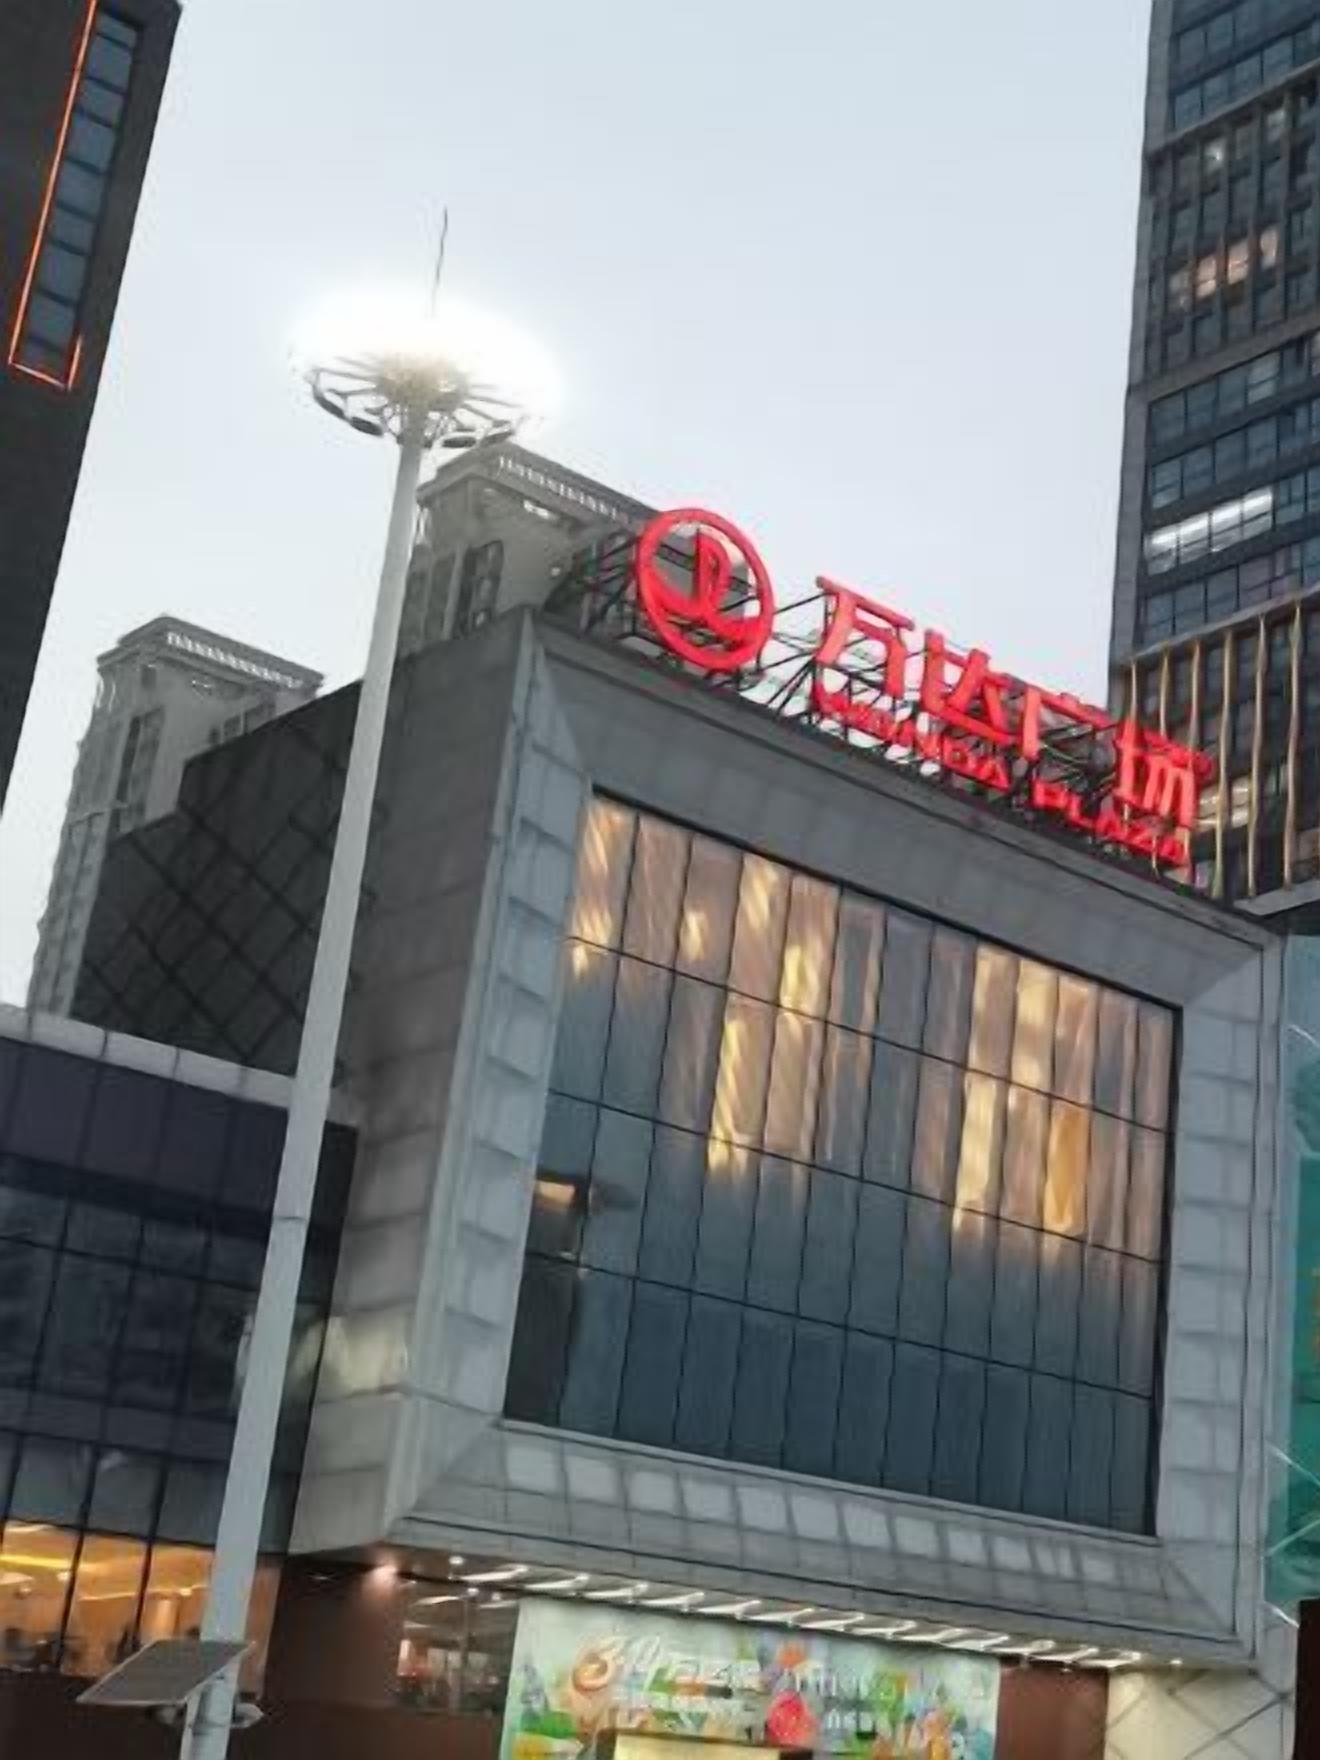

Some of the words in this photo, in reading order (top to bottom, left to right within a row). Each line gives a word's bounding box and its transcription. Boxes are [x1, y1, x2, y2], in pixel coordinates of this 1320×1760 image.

[816, 576, 1214, 832] 万达广场
[1033, 776, 1192, 866] PLAZA
